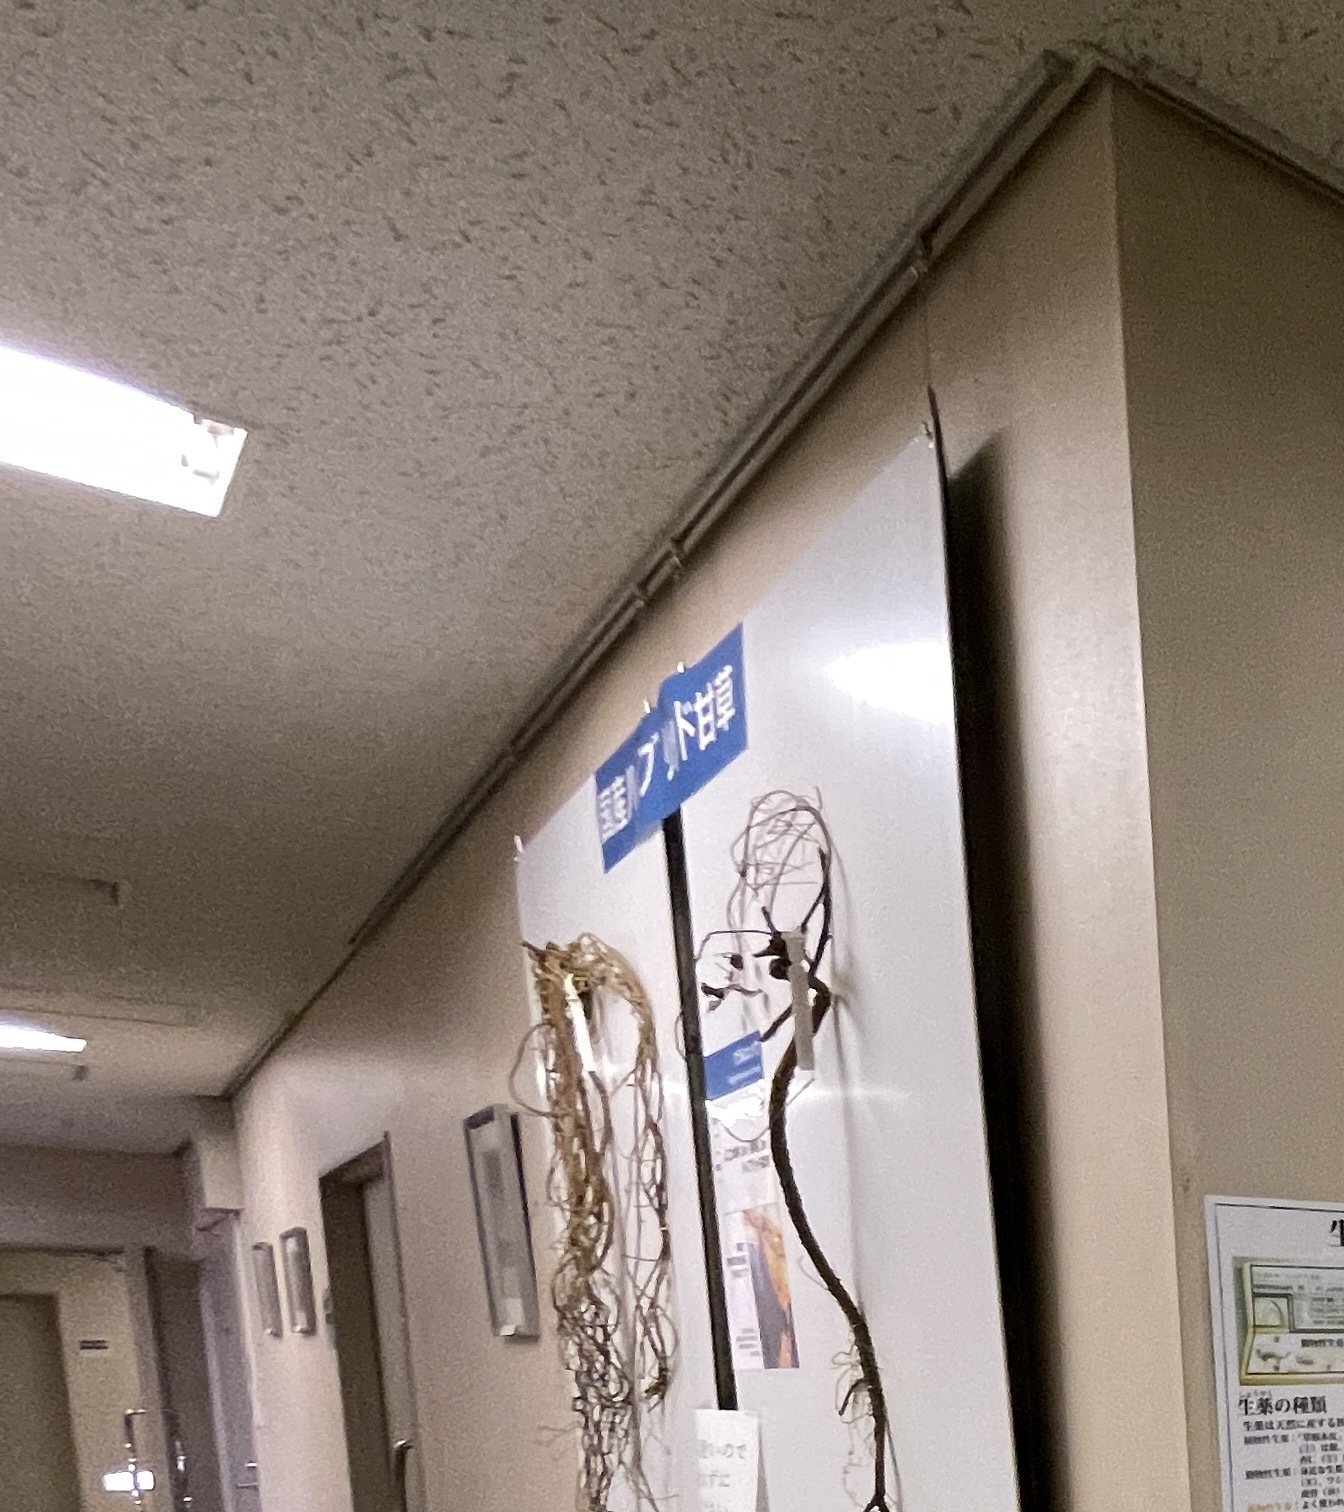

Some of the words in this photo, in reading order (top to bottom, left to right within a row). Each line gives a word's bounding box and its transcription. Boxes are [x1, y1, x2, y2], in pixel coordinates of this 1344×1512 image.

[1237, 1395, 1326, 1416] 生薬の種類
